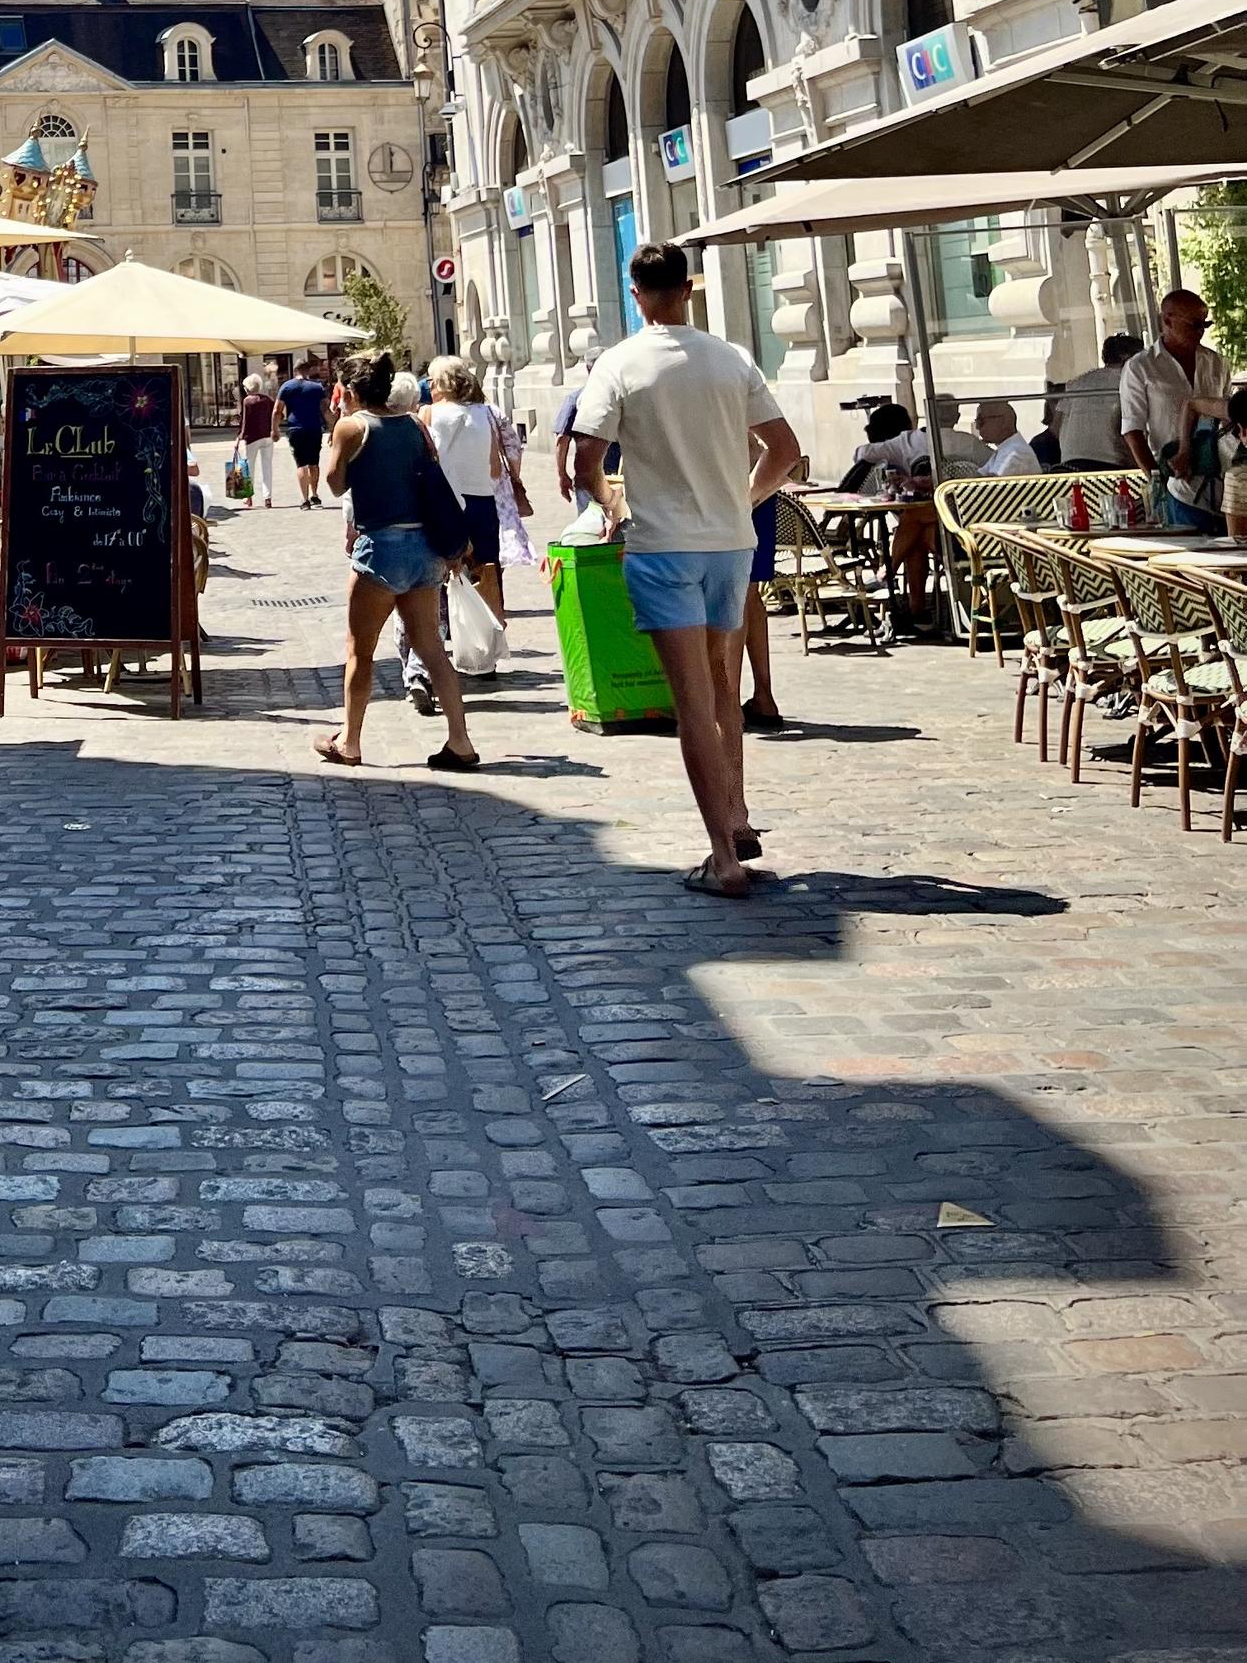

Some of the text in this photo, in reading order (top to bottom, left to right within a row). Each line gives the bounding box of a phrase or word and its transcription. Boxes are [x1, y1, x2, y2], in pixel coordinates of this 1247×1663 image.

[911, 42, 948, 81] CIC
[664, 136, 687, 163] CIC
[50, 485, 102, 503] Ambiance
